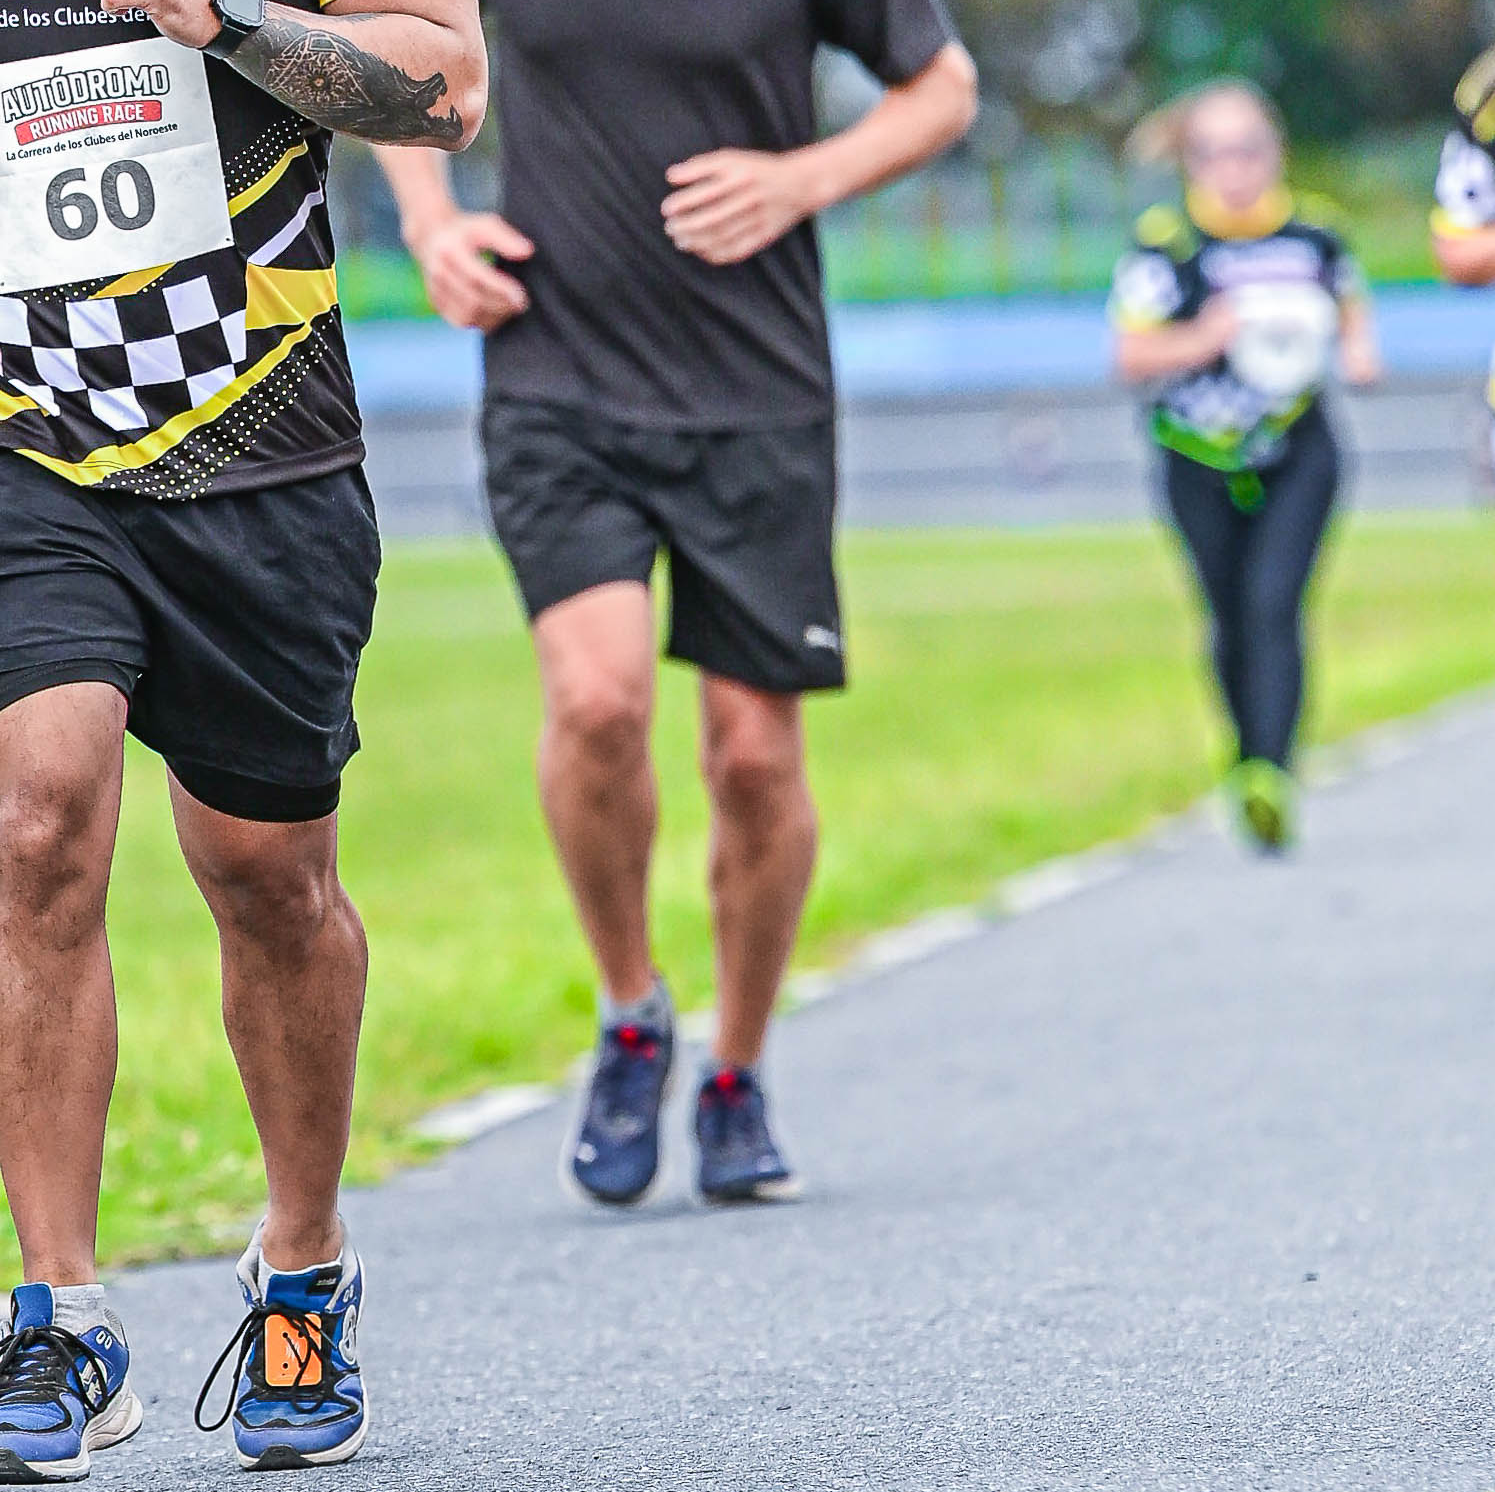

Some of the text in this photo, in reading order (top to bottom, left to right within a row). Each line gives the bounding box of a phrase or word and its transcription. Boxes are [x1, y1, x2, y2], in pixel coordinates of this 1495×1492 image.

[23, 8, 51, 27] los
[54, 6, 117, 26] Clubes
[122, 7, 151, 23] de
[1, 64, 171, 123] AUTÓDROMO
[29, 103, 145, 140] RUNNING RACE
[6, 123, 179, 161] La Carrera de los Clubes del Noroeste
[46, 160, 156, 241] 60
